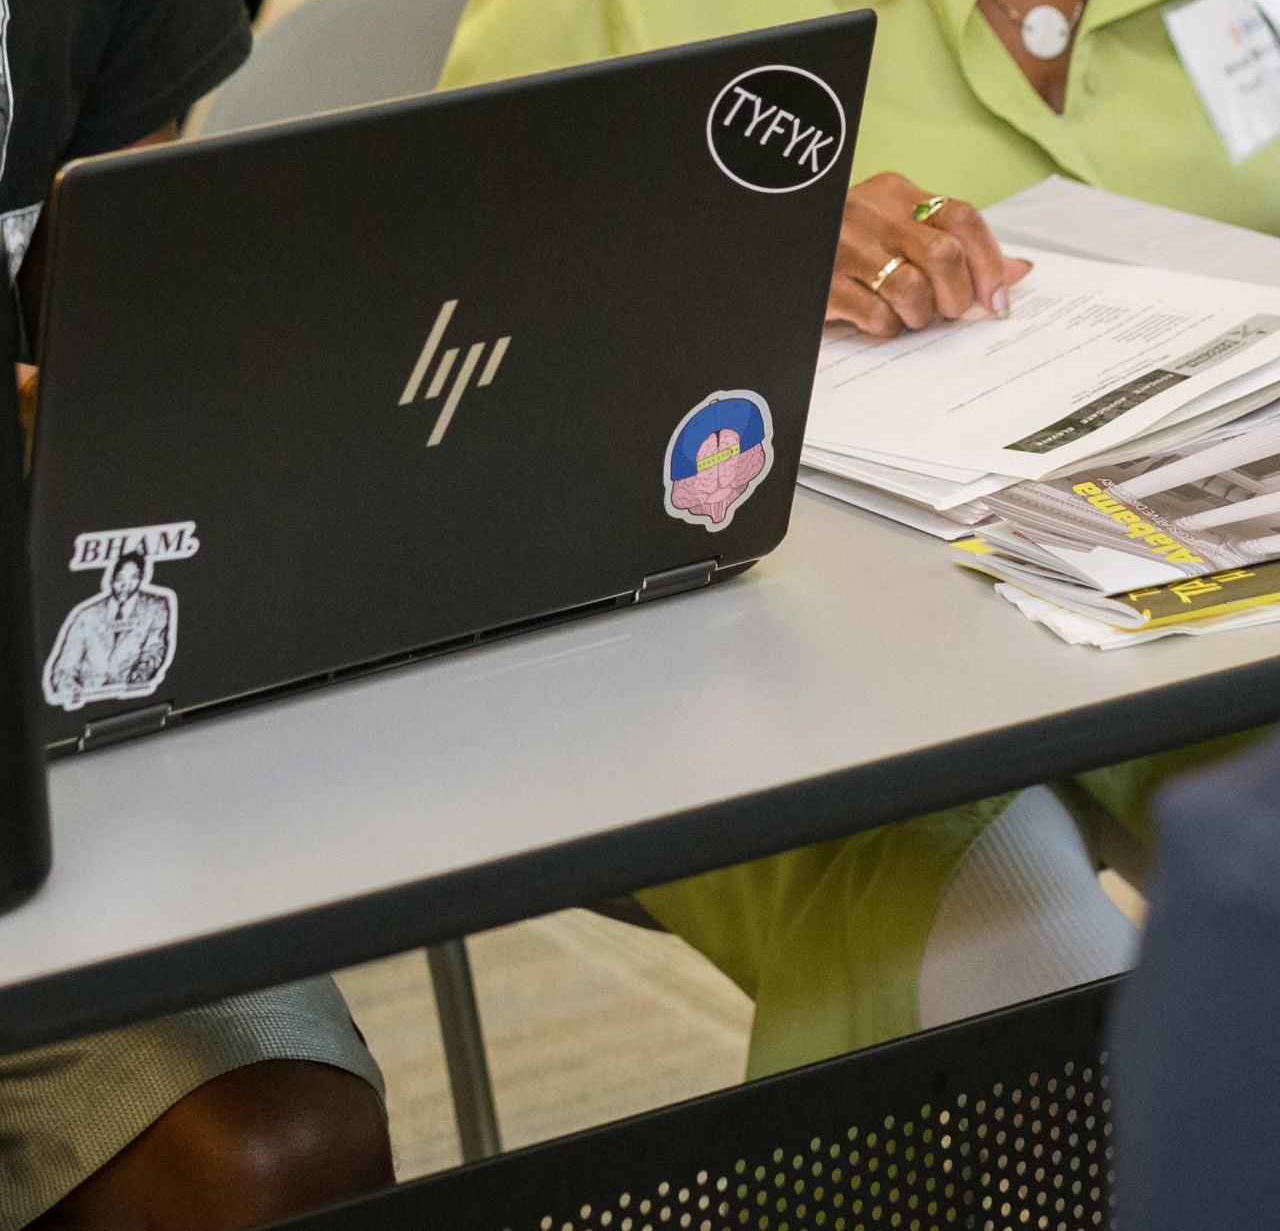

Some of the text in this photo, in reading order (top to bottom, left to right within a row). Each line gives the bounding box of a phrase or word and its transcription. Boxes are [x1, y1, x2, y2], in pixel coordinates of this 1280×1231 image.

[723, 86, 833, 173] TYFYK
[1080, 397, 1127, 425] ADVOCATE
[1034, 426, 1075, 447] ELEVATE
[1072, 481, 1205, 563] Alabama
[79, 529, 192, 563] BHAM.
